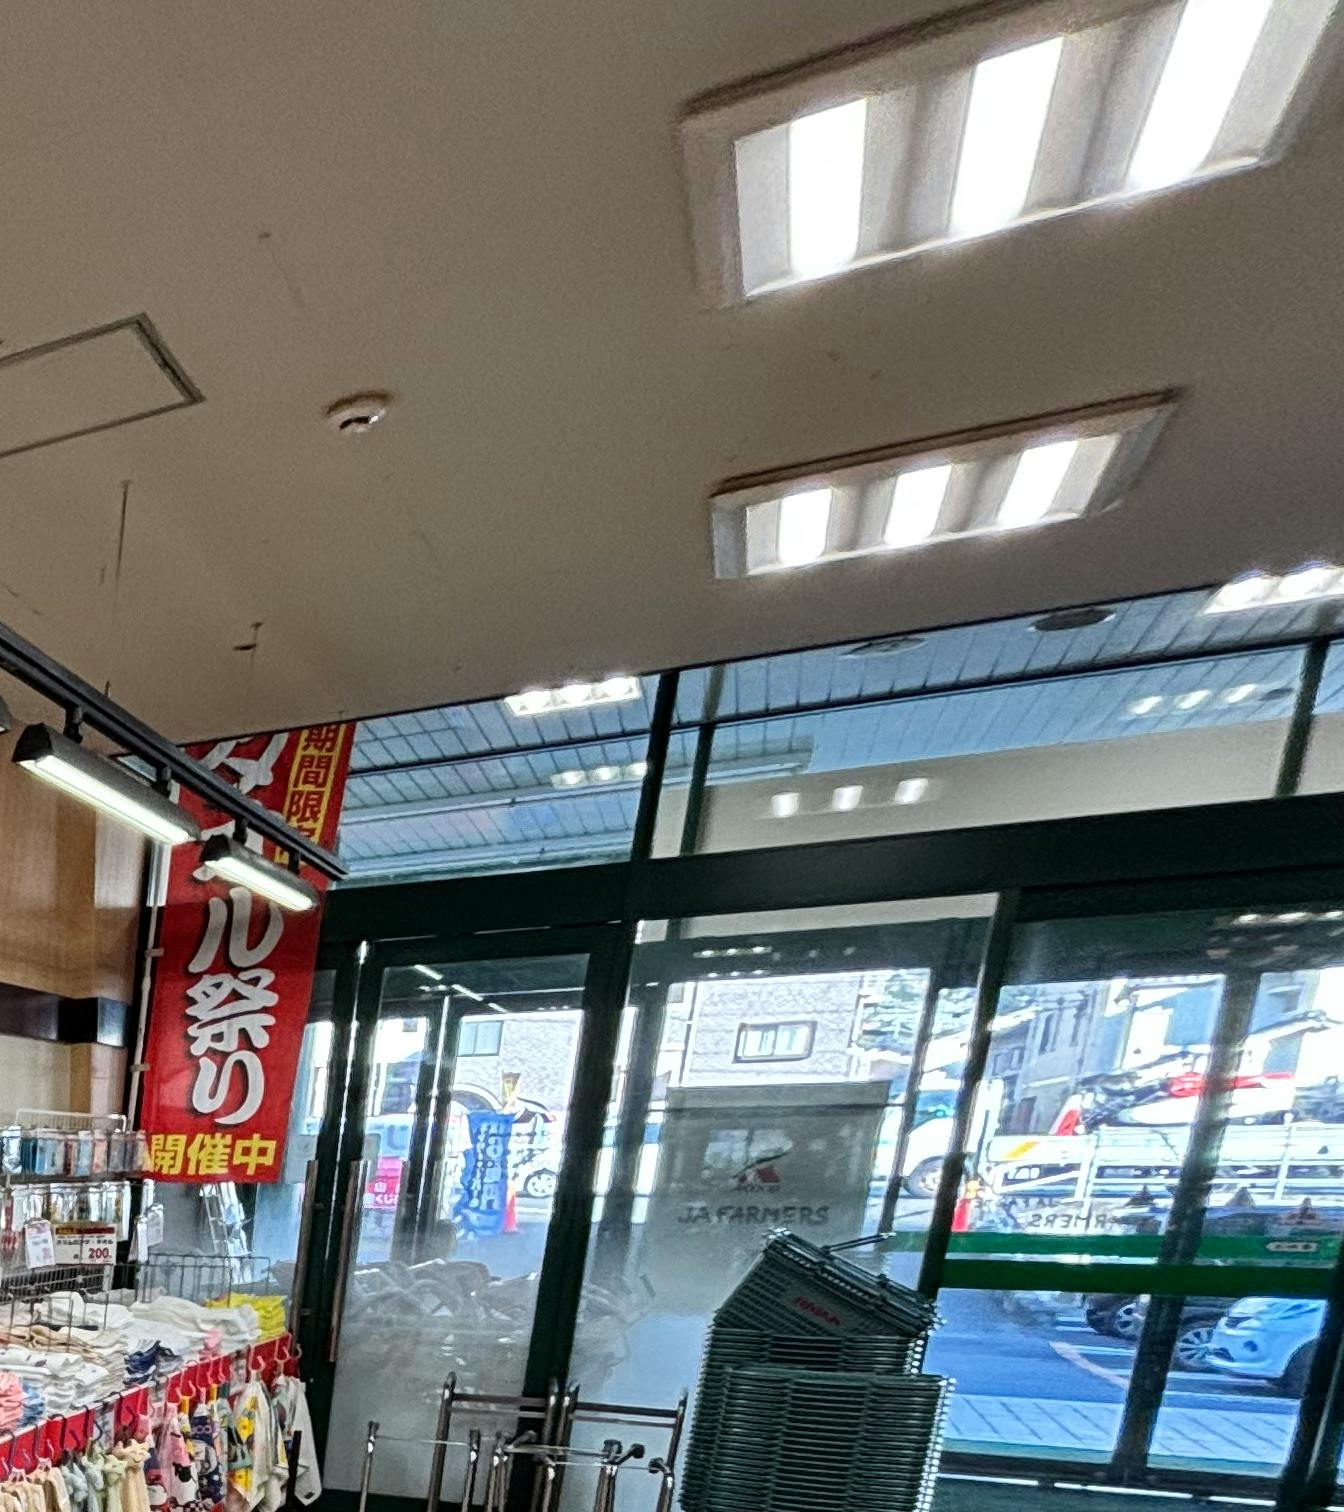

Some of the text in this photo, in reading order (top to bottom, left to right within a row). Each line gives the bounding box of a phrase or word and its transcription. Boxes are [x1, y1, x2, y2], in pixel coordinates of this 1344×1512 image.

[150, 1132, 276, 1176] 開催中
[678, 1205, 831, 1225] JA FARMERS
